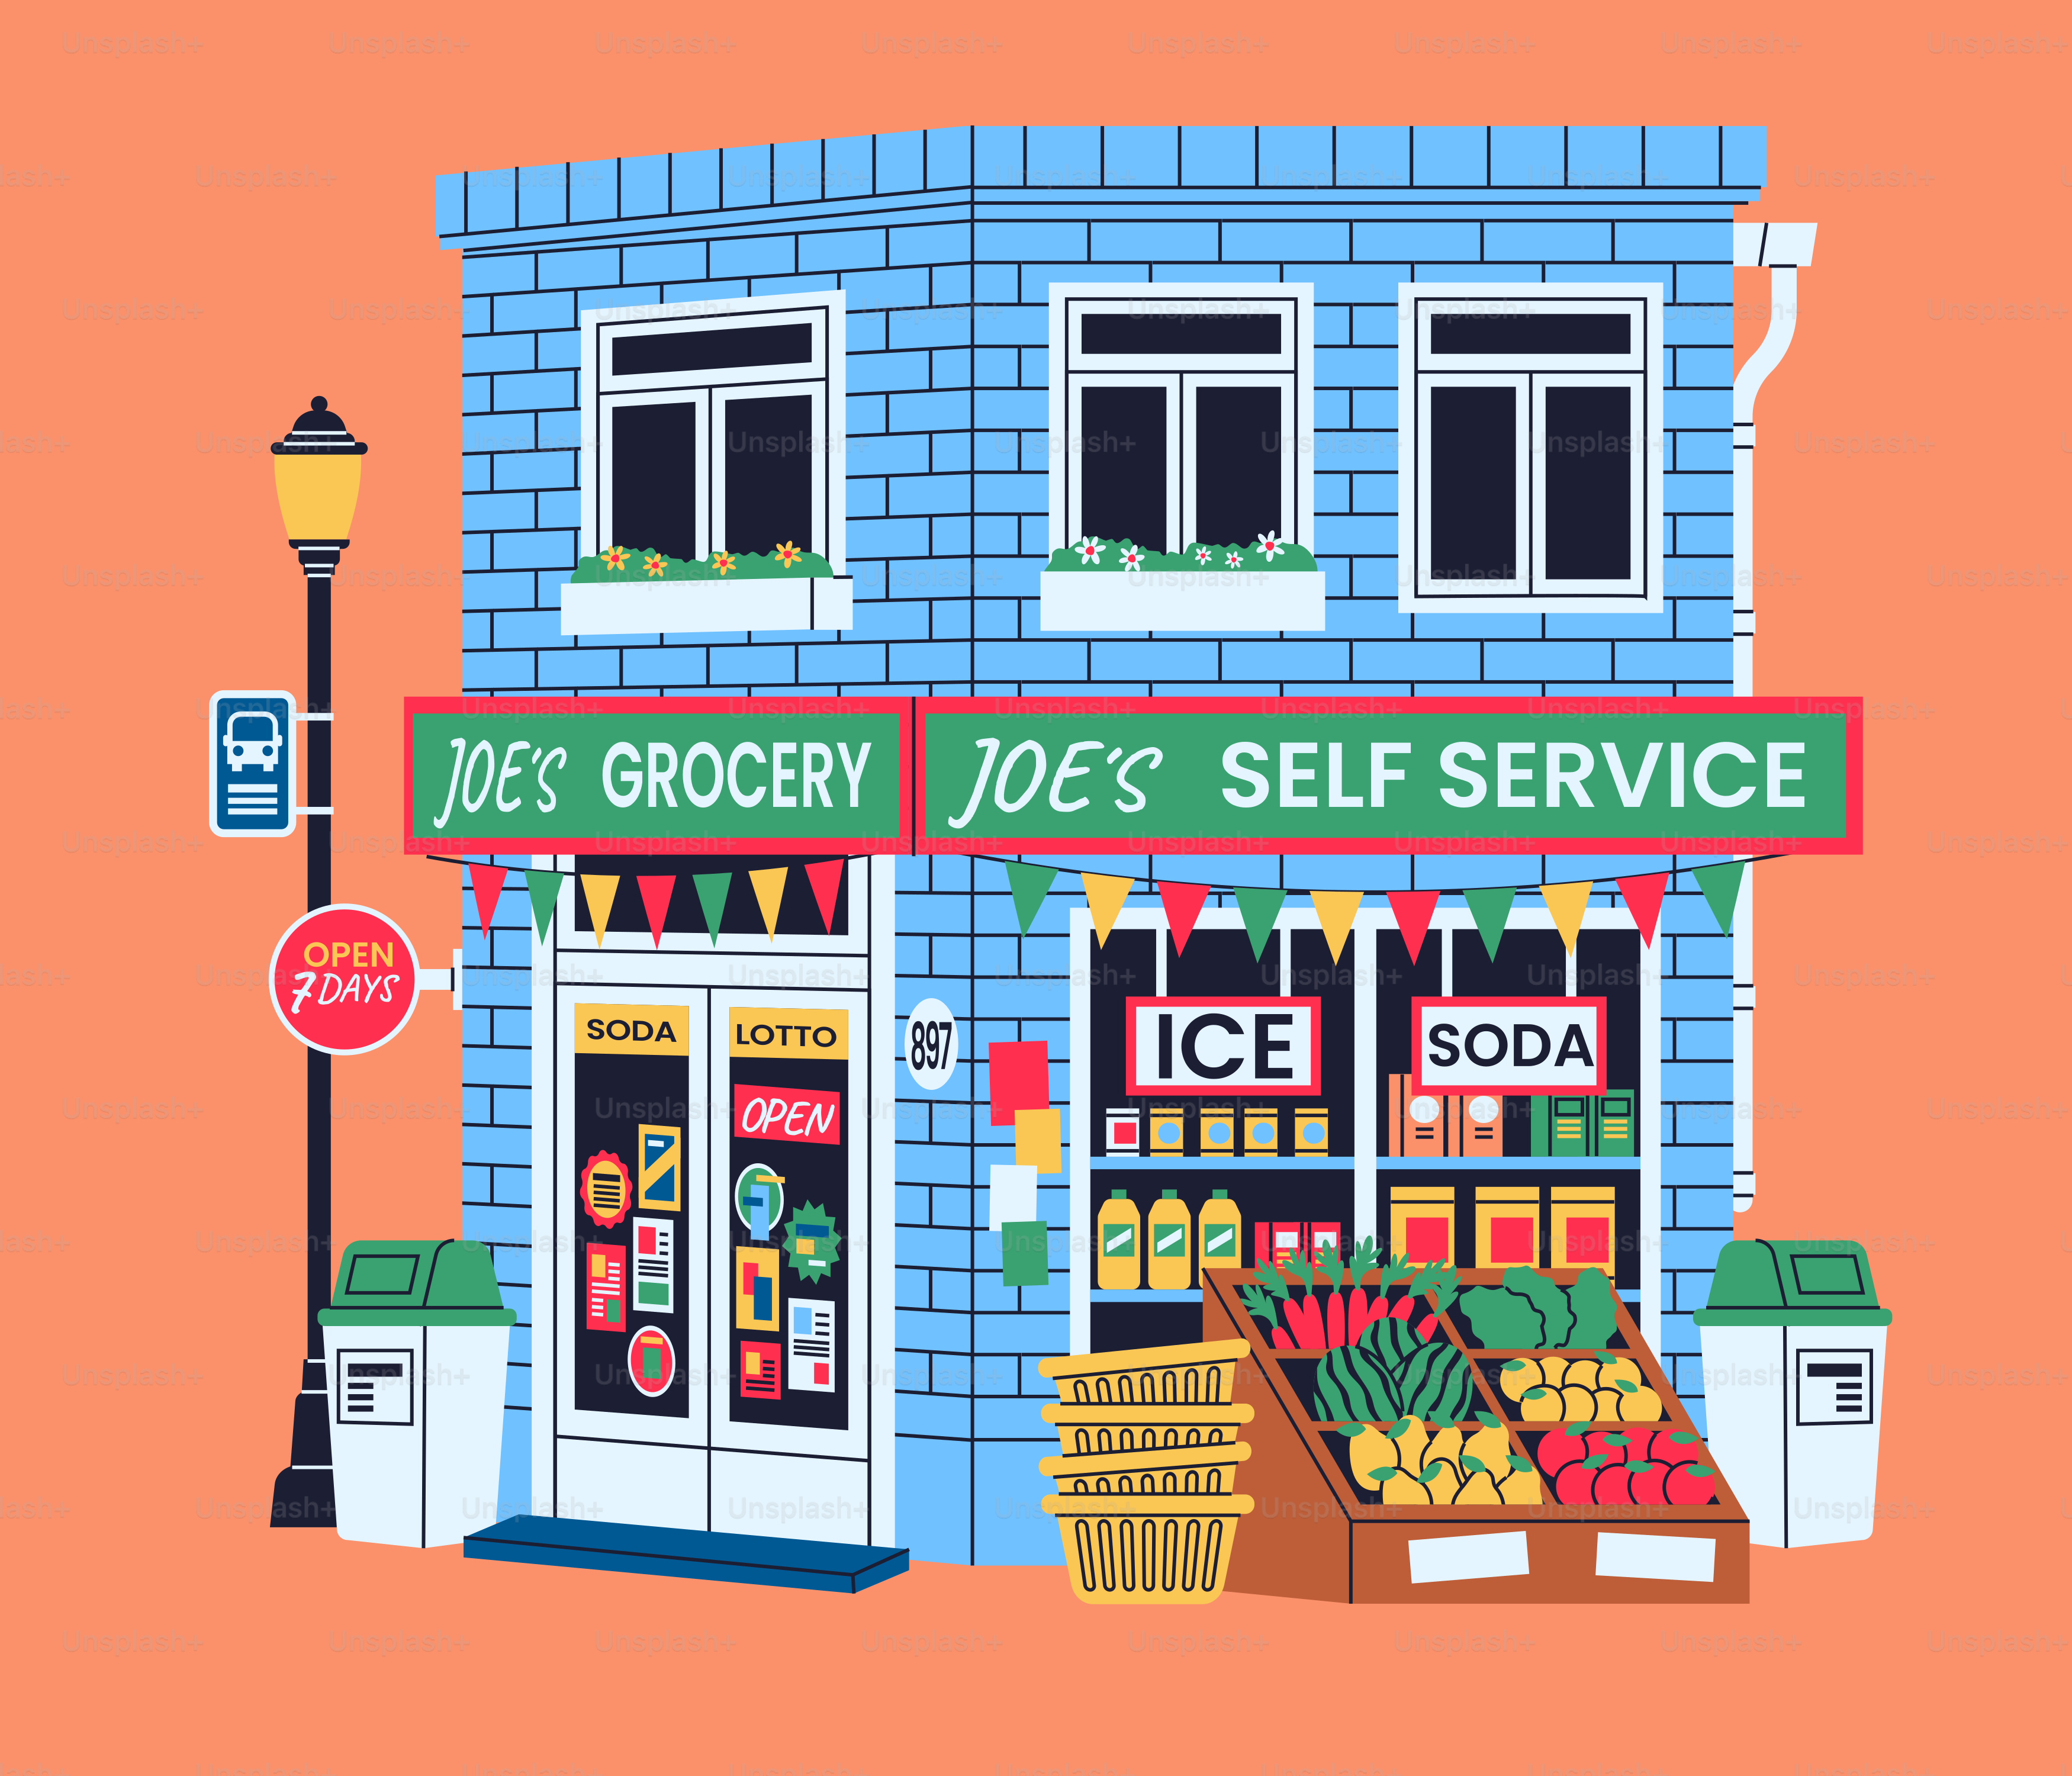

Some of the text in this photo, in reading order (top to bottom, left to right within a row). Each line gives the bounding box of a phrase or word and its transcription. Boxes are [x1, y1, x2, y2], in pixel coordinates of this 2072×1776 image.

[433, 737, 872, 829] JOE'S GROCERY
[948, 737, 1805, 829] JOE'S SELF SERVICE
[304, 941, 393, 967] OPEN
[291, 971, 400, 1015] 7 DAYS
[587, 1018, 677, 1043] SODA
[736, 1023, 837, 1048] LOTTO
[910, 1020, 953, 1070] 897
[1158, 1013, 1294, 1079] ICE
[1428, 1023, 1594, 1067] SODA
[741, 1097, 835, 1137] OPEN
